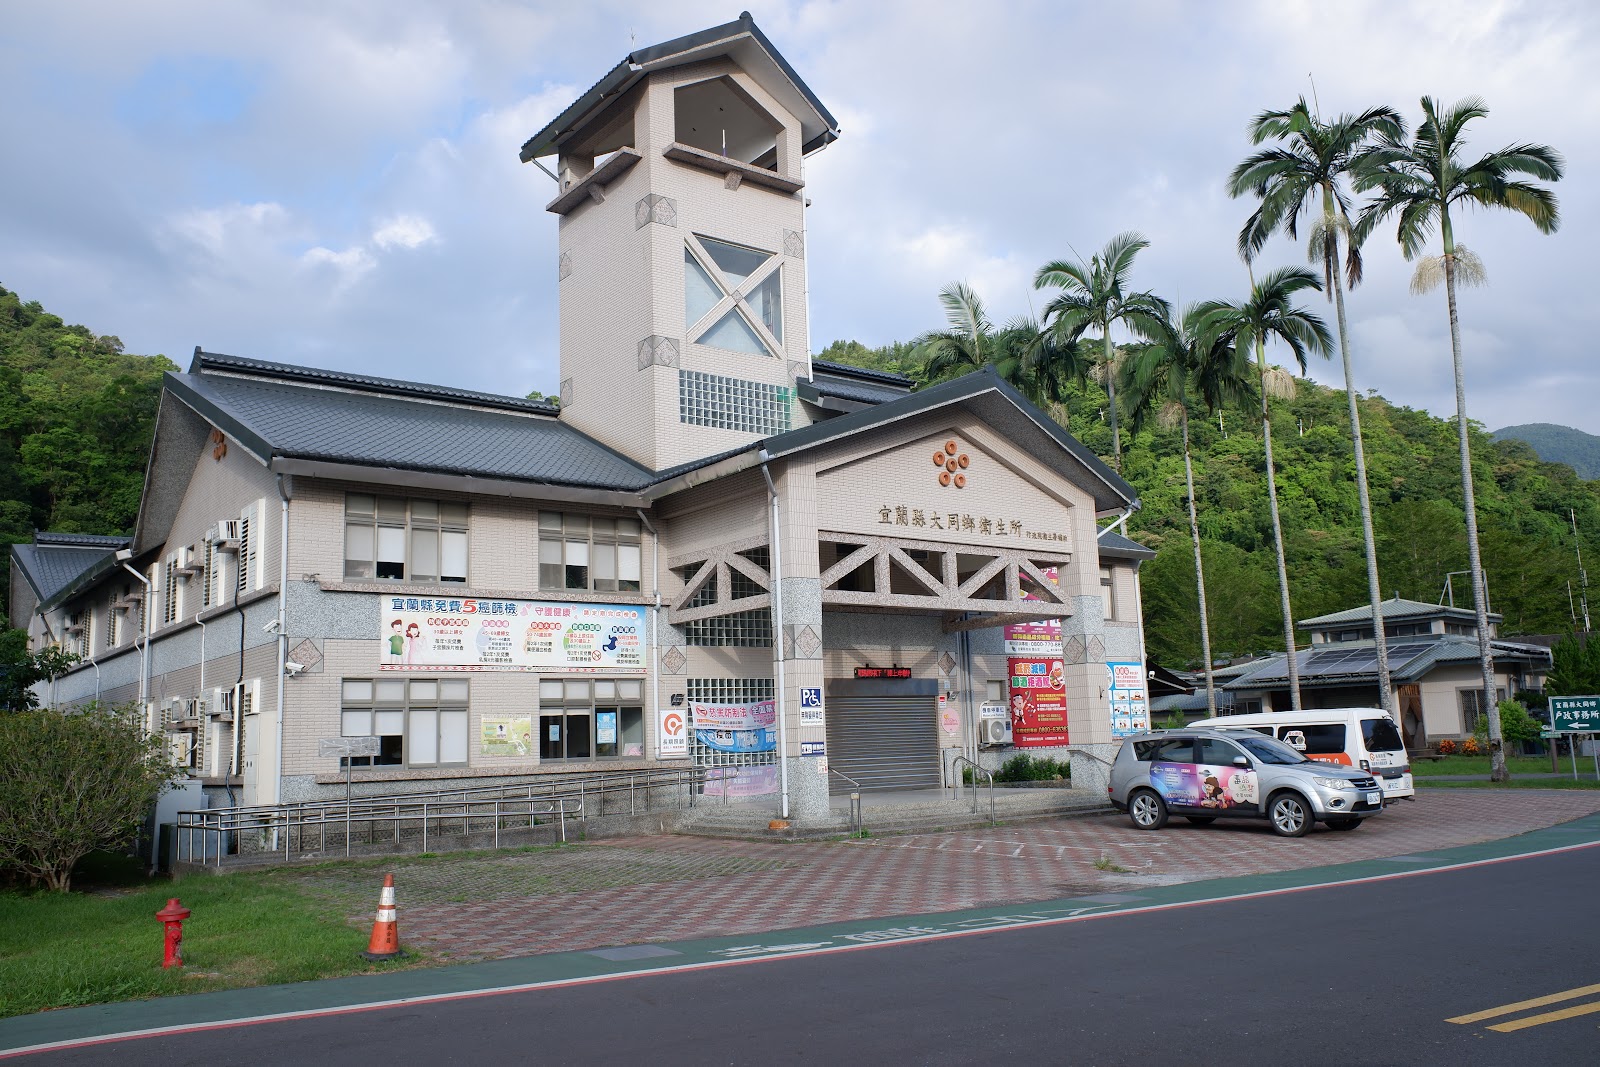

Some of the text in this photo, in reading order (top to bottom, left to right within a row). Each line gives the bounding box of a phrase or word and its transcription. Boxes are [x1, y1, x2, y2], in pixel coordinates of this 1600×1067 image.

[878, 505, 1022, 537] 宜蘭縣大同鄉衛生所
[392, 598, 518, 616] 宜蘭縣免費5癌篩檢
[535, 607, 571, 617] 守護健康
[1555, 710, 1600, 720] 戶政事務所
